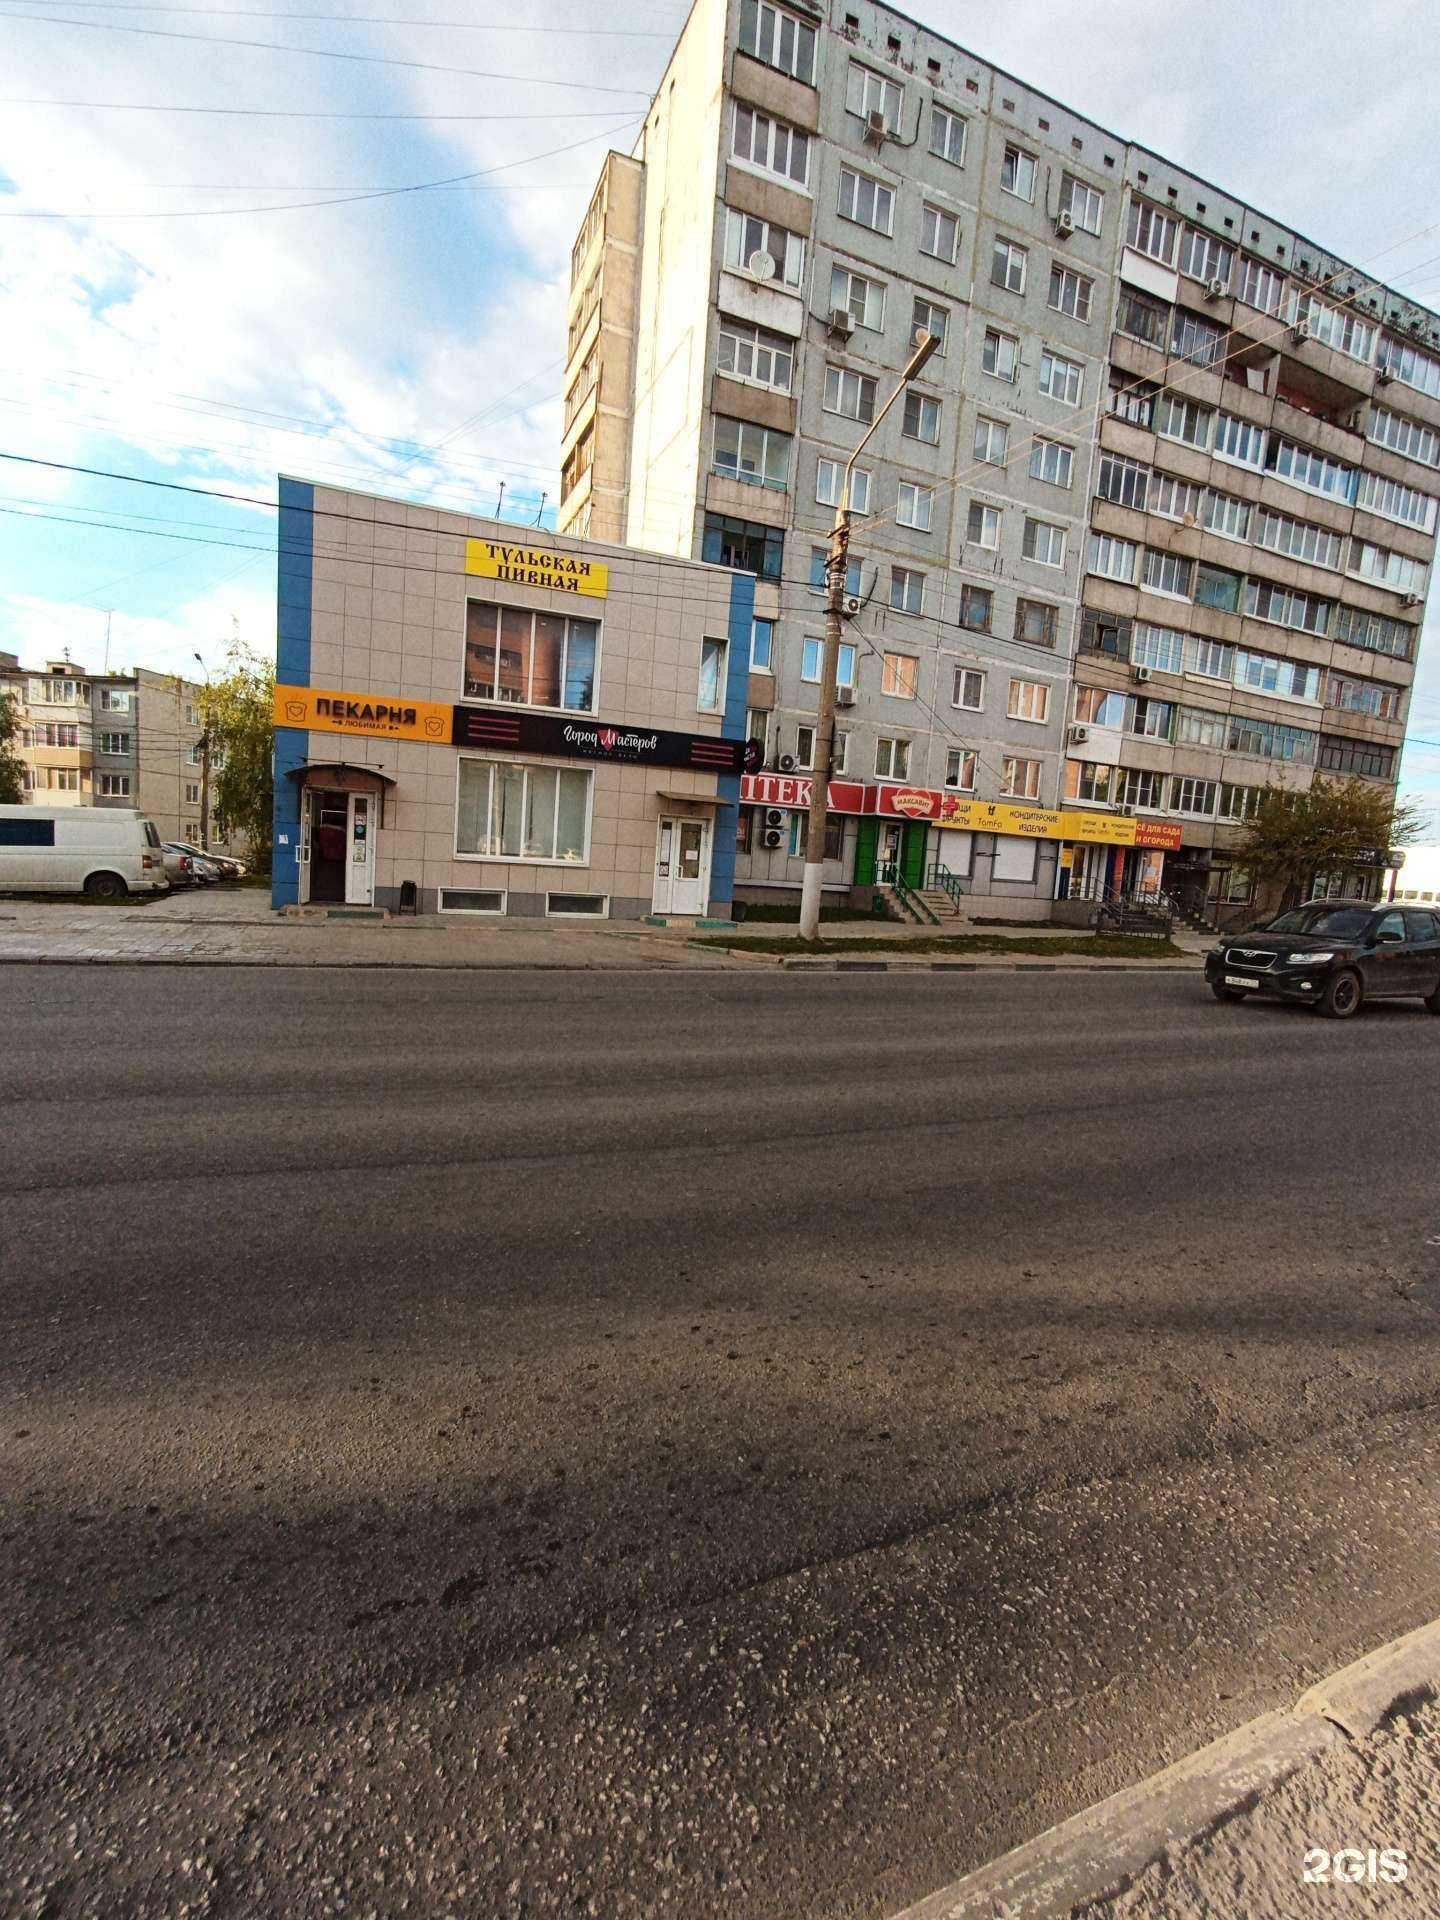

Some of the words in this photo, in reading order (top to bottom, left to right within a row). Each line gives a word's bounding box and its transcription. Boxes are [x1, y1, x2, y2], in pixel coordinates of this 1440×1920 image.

[485, 543, 591, 576] ТУЛЬСКАЯ
[497, 564, 579, 591] ПИВНАЯ
[316, 698, 417, 725] ПЕКАРНЯ
[343, 720, 387, 731] ЛЮБИМАЯ
[563, 725, 598, 748] Город
[601, 728, 658, 752] Мастеров
[1009, 810, 1059, 824] КОНДИТЕРСКИЕ
[1018, 824, 1048, 833] ИЗДЕЛИЯ
[1142, 836, 1174, 847] ОГОРОДА
